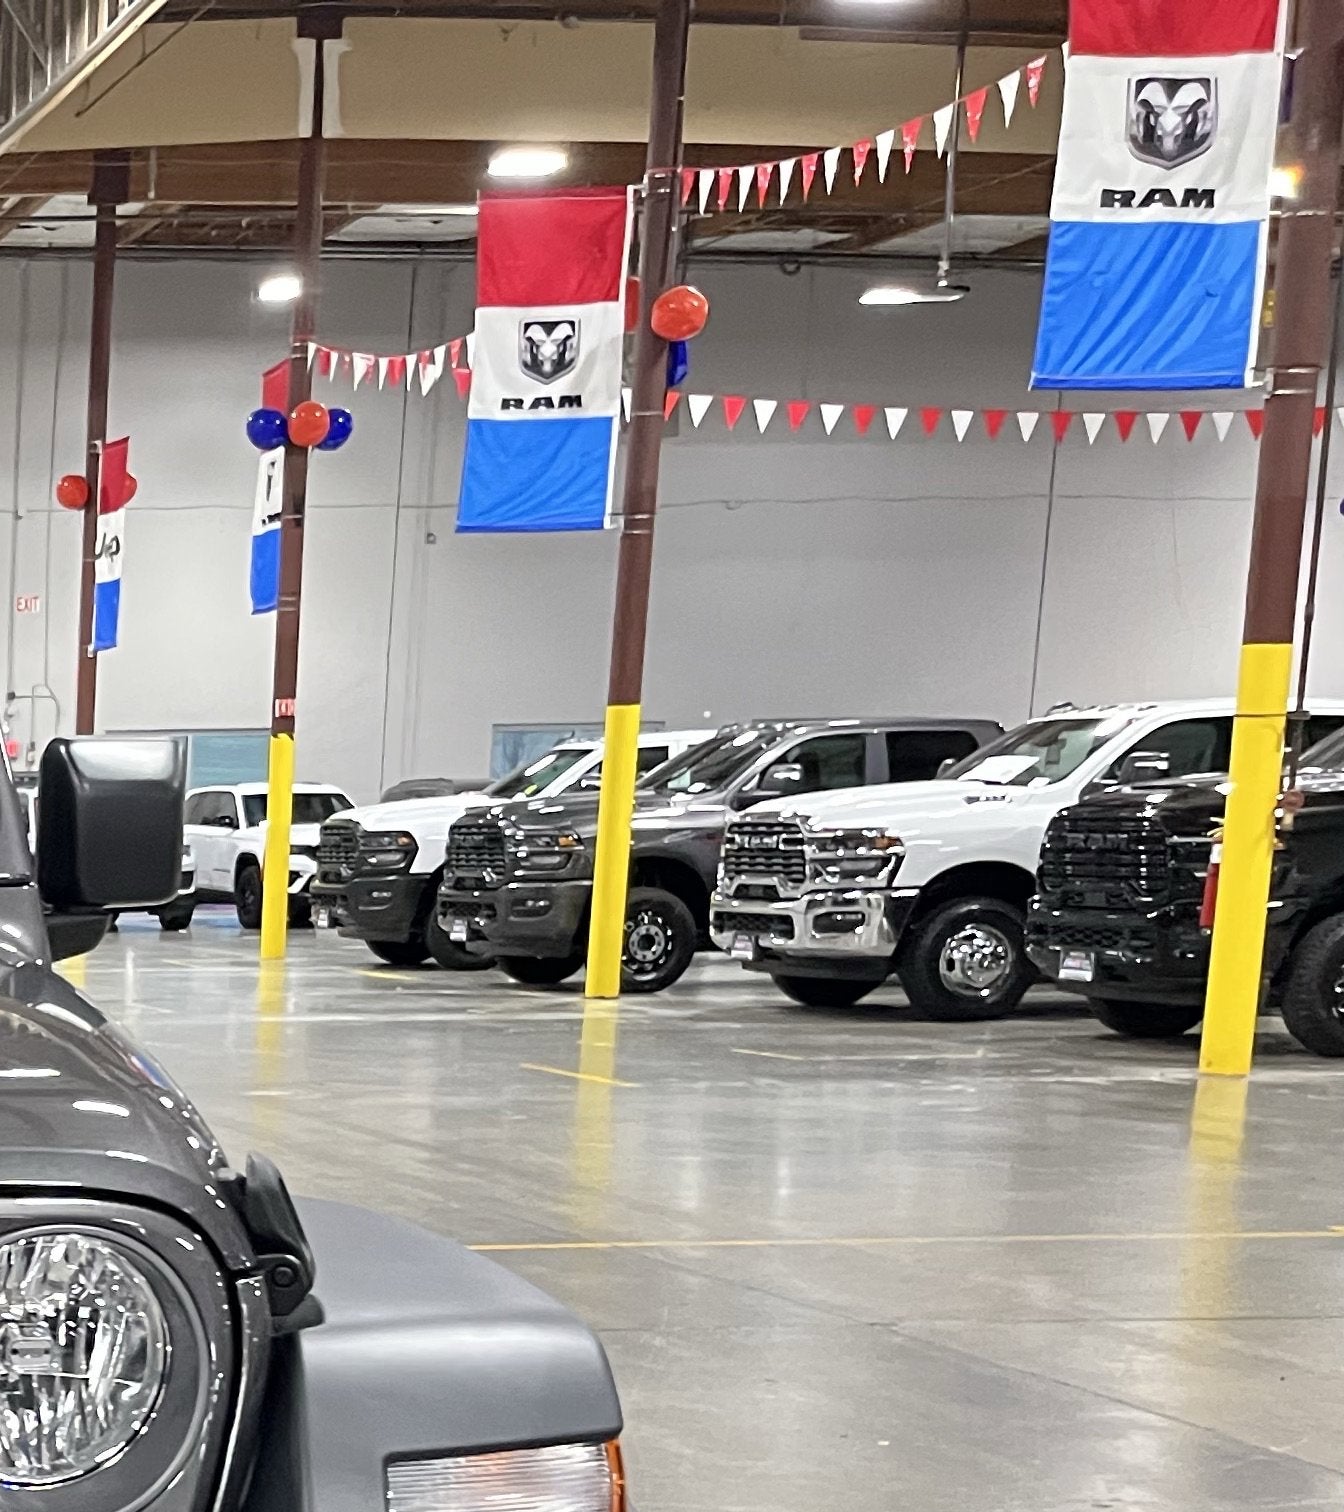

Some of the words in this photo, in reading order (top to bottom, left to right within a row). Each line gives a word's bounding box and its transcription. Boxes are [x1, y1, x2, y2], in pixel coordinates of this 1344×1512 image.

[1100, 188, 1215, 208] RAM
[500, 395, 582, 410] RAM
[16, 596, 39, 612] EXIT
